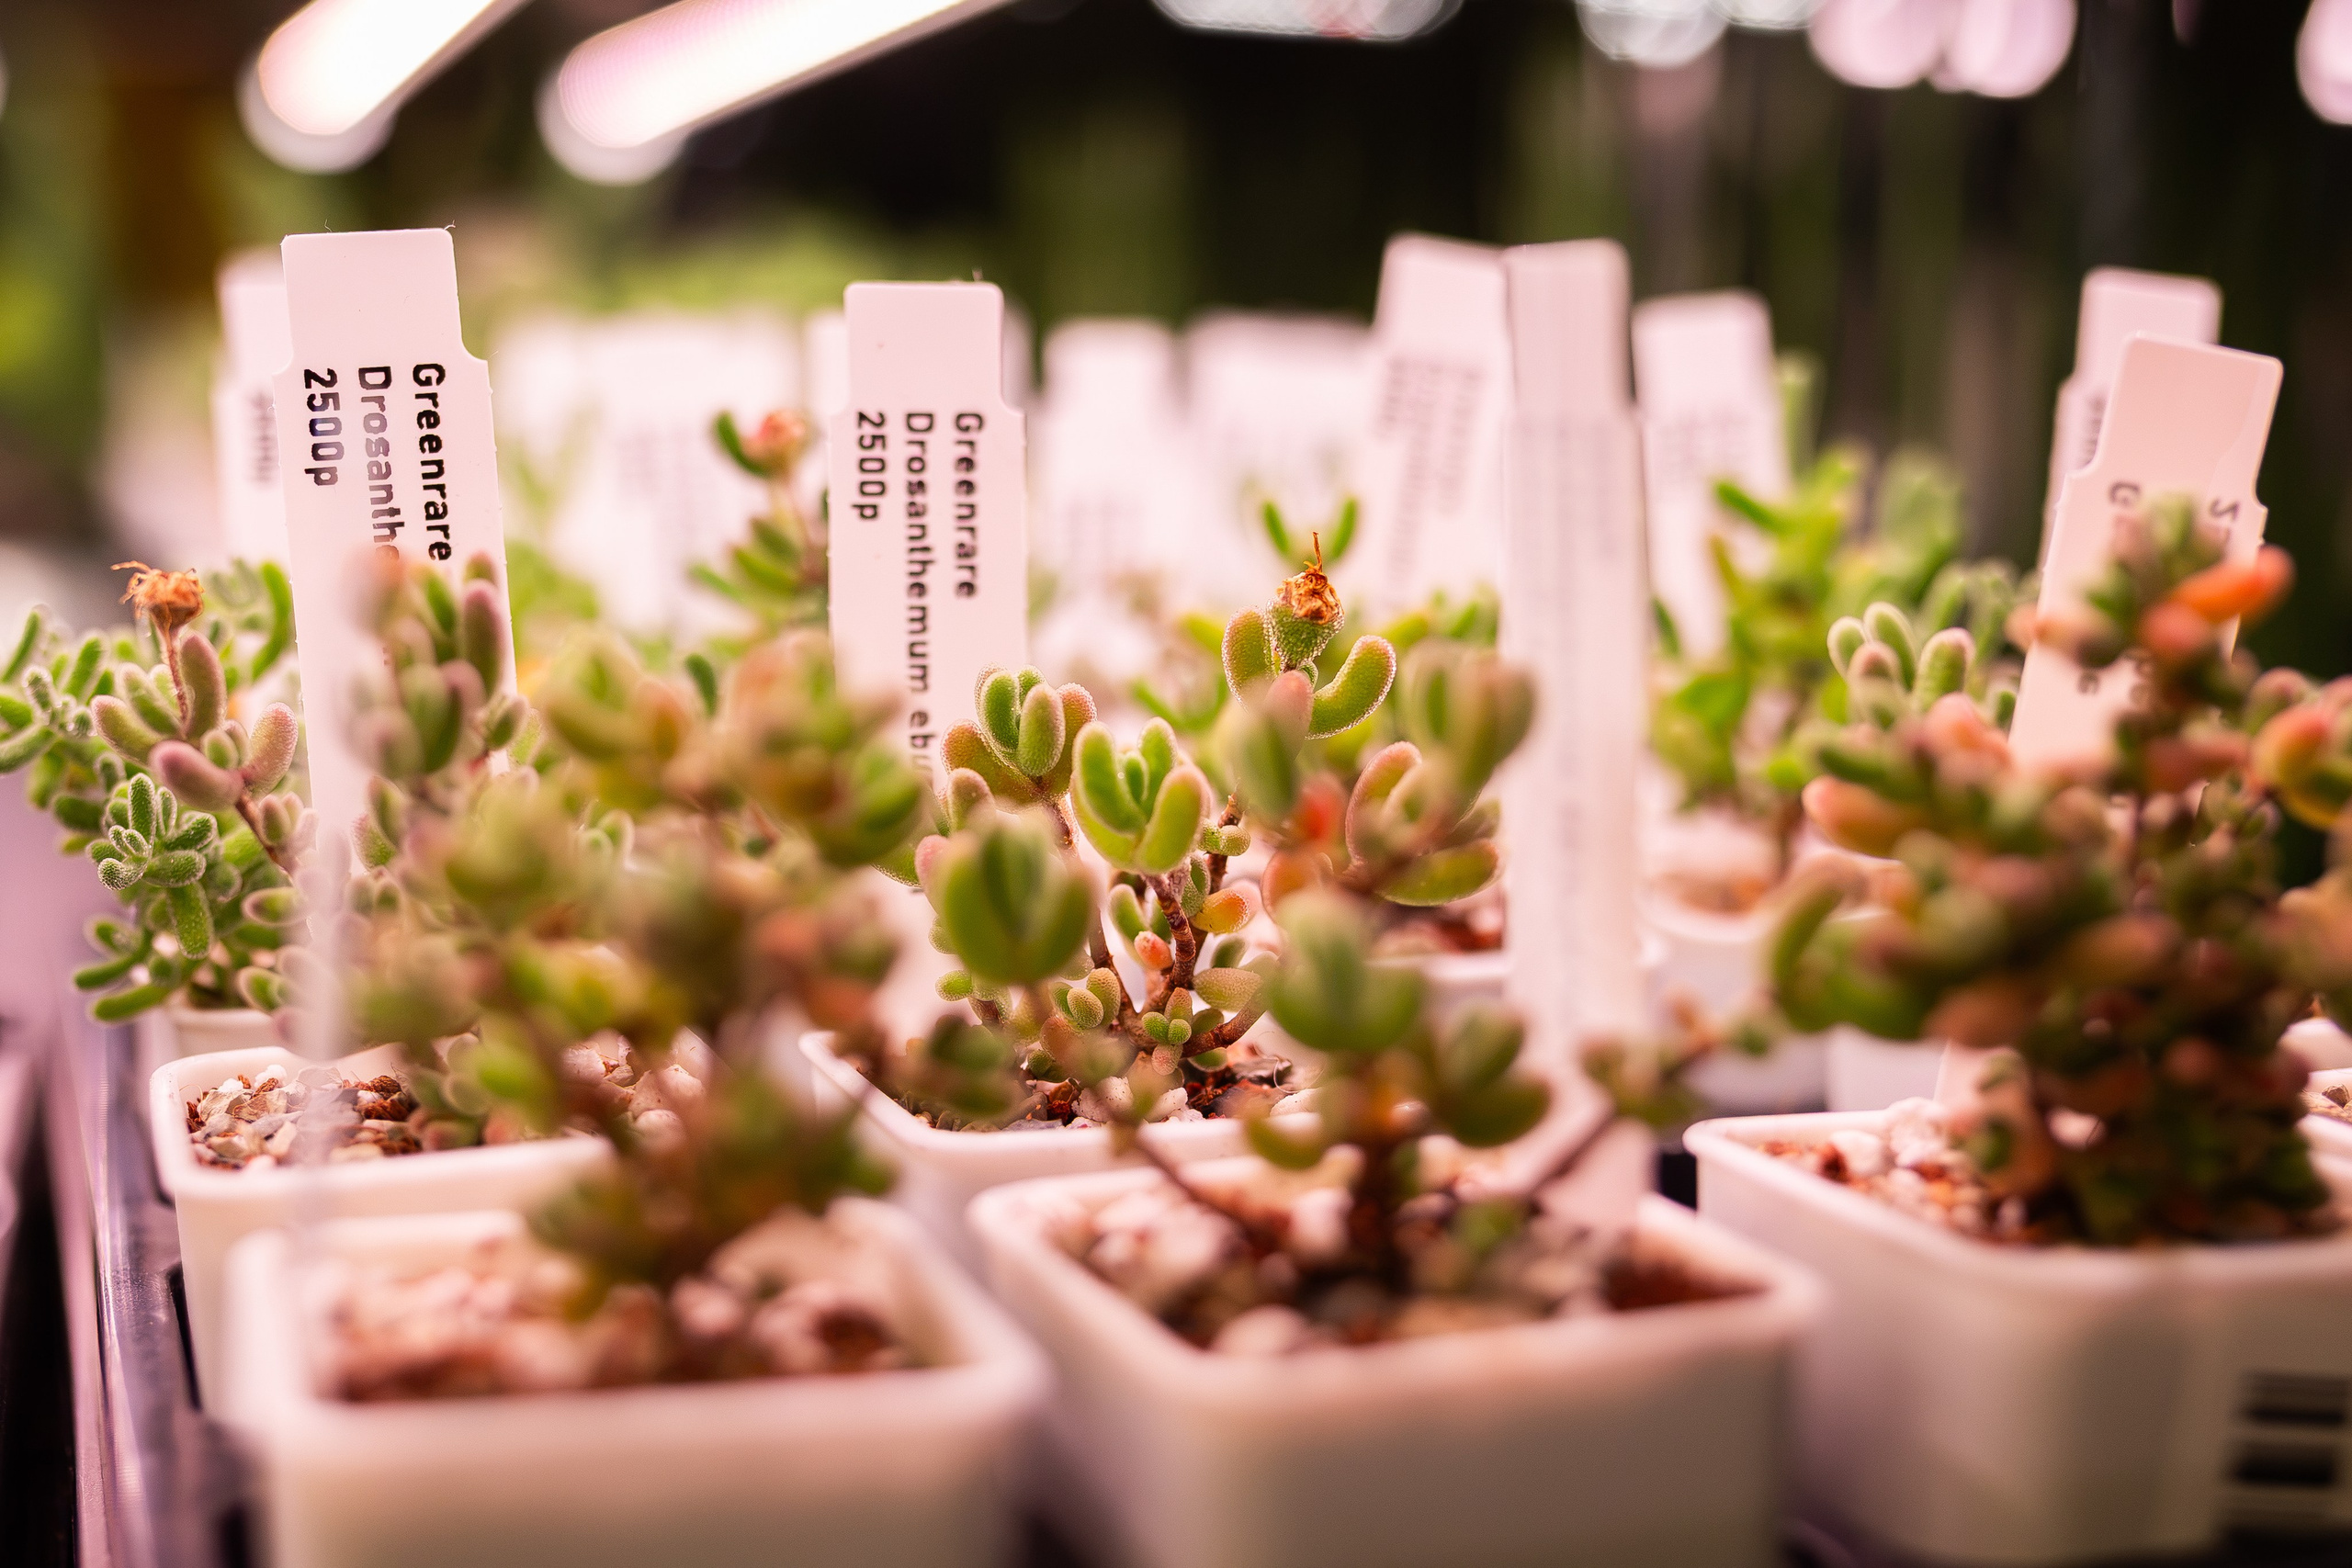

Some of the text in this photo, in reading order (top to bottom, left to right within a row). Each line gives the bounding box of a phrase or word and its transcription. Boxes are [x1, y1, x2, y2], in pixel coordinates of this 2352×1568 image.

[303, 367, 345, 487] 2500p
[412, 363, 452, 561] Greenrare
[852, 411, 888, 521] 2500p
[953, 412, 985, 598] Greenrare
[905, 412, 935, 694] Drosanthemum
